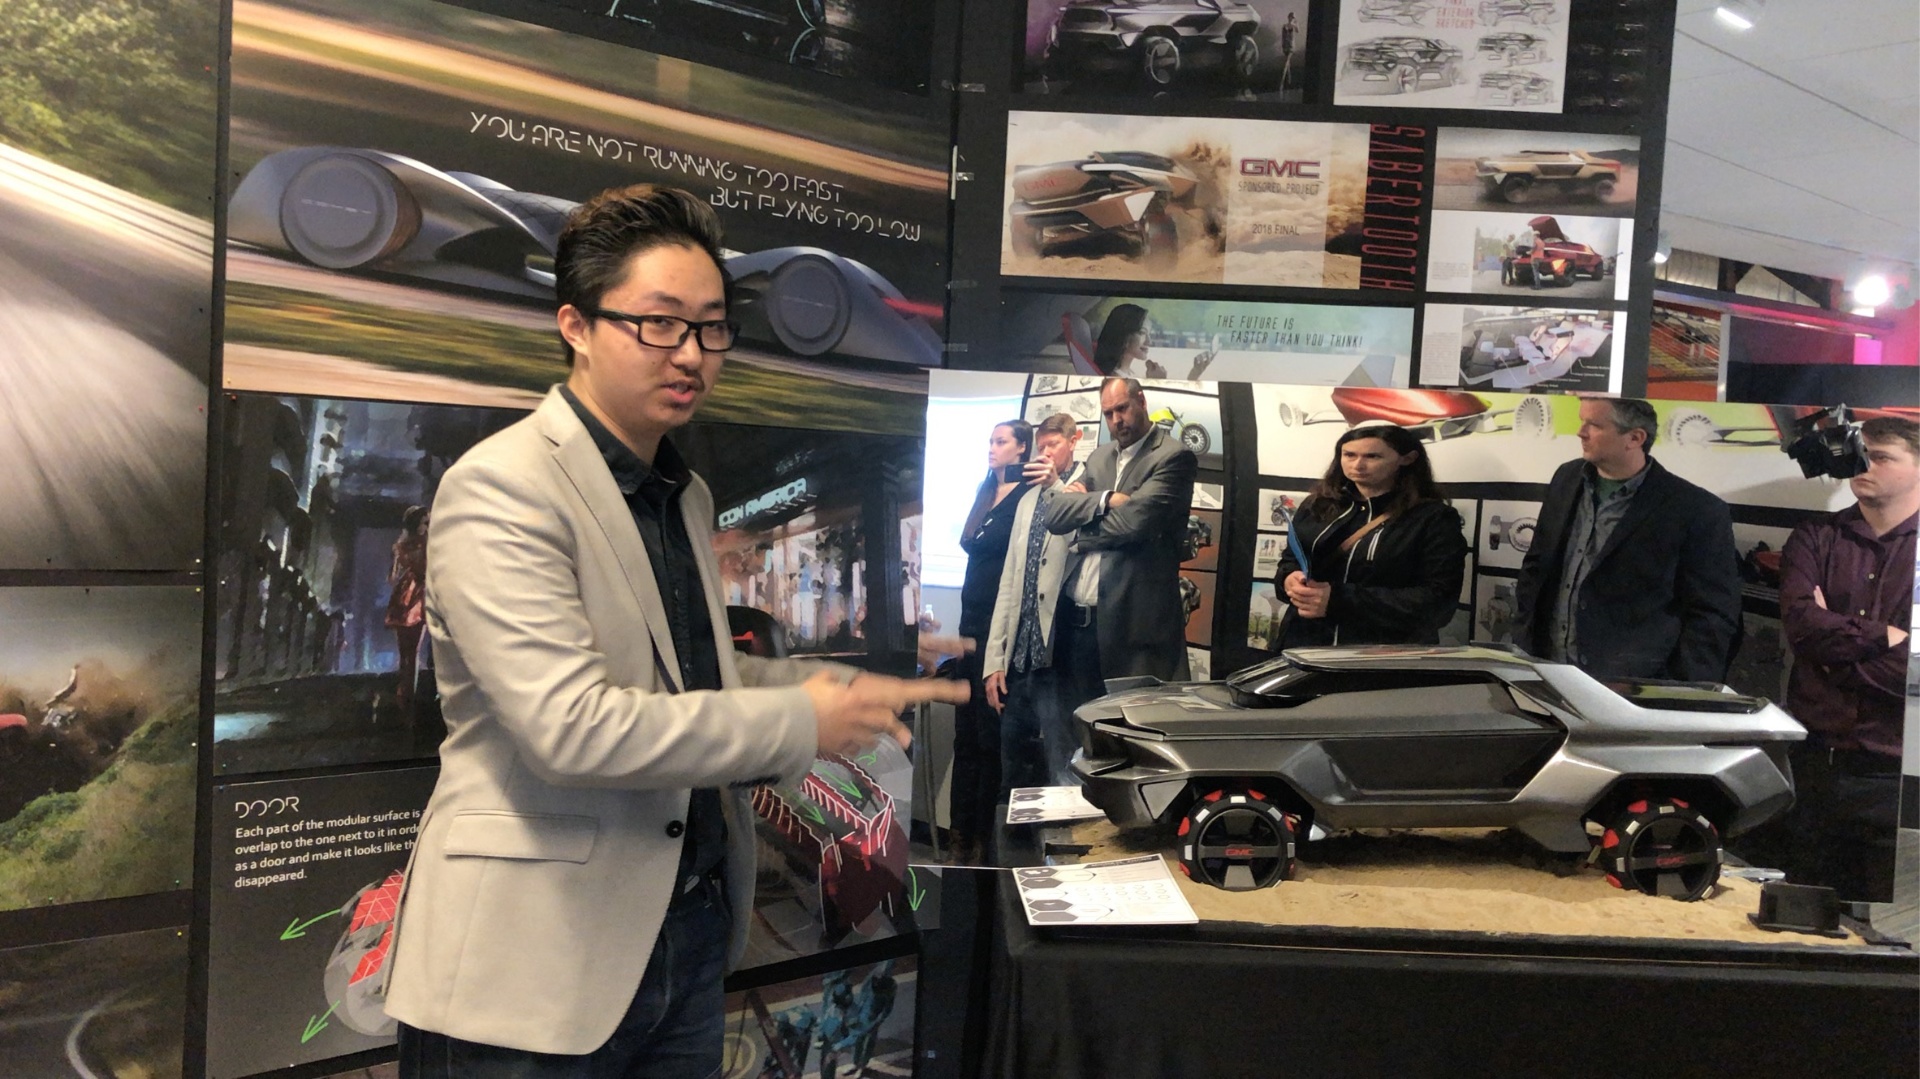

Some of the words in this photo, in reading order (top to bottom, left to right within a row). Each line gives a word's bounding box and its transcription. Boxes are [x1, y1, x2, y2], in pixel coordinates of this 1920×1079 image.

[470, 111, 526, 142] YOU
[532, 124, 581, 153] ARE
[587, 134, 638, 162] NOT
[643, 145, 737, 181] RUNNING
[743, 165, 789, 191] TOO
[794, 175, 844, 203] FAST
[1240, 158, 1321, 179] GMC
[1238, 180, 1281, 194] SPONSORED
[1286, 183, 1320, 196] PROJECT
[710, 186, 753, 211] BUT
[758, 194, 828, 224] FLYING
[834, 208, 874, 233] TOO
[878, 217, 921, 242] LOW
[1360, 123, 1426, 292] SABERTOOTH
[1252, 223, 1272, 235] 2018
[1274, 224, 1300, 236] FINAL
[1216, 315, 1235, 329] THE
[1240, 315, 1278, 330] FUTURE
[1283, 317, 1295, 330] IS
[1230, 330, 1269, 344] FASTER
[1274, 331, 1300, 345] THAN
[1306, 333, 1324, 347] YOU
[1330, 334, 1363, 348] THINK!
[235, 796, 300, 819] DOOR
[235, 825, 264, 838] Each
[266, 823, 290, 838] part
[291, 820, 305, 832] of
[306, 819, 324, 830] the
[326, 814, 371, 828] modular
[373, 810, 410, 822] surface
[412, 808, 421, 818] is
[235, 841, 278, 855] overlap
[280, 840, 293, 849] to
[295, 836, 313, 848] the
[315, 836, 336, 845] one
[338, 831, 362, 842] next
[364, 830, 375, 839] to
[377, 828, 385, 837] it
[387, 827, 397, 836] in
[1224, 848, 1255, 856] GMC
[235, 862, 248, 871] as
[250, 861, 257, 869] a
[260, 857, 287, 868] door
[288, 852, 310, 864] and
[312, 849, 342, 861] make
[344, 847, 352, 857] it
[354, 843, 382, 856] looks
[384, 841, 402, 852] like
[404, 839, 415, 850] th
[234, 868, 308, 888] disappeared.
